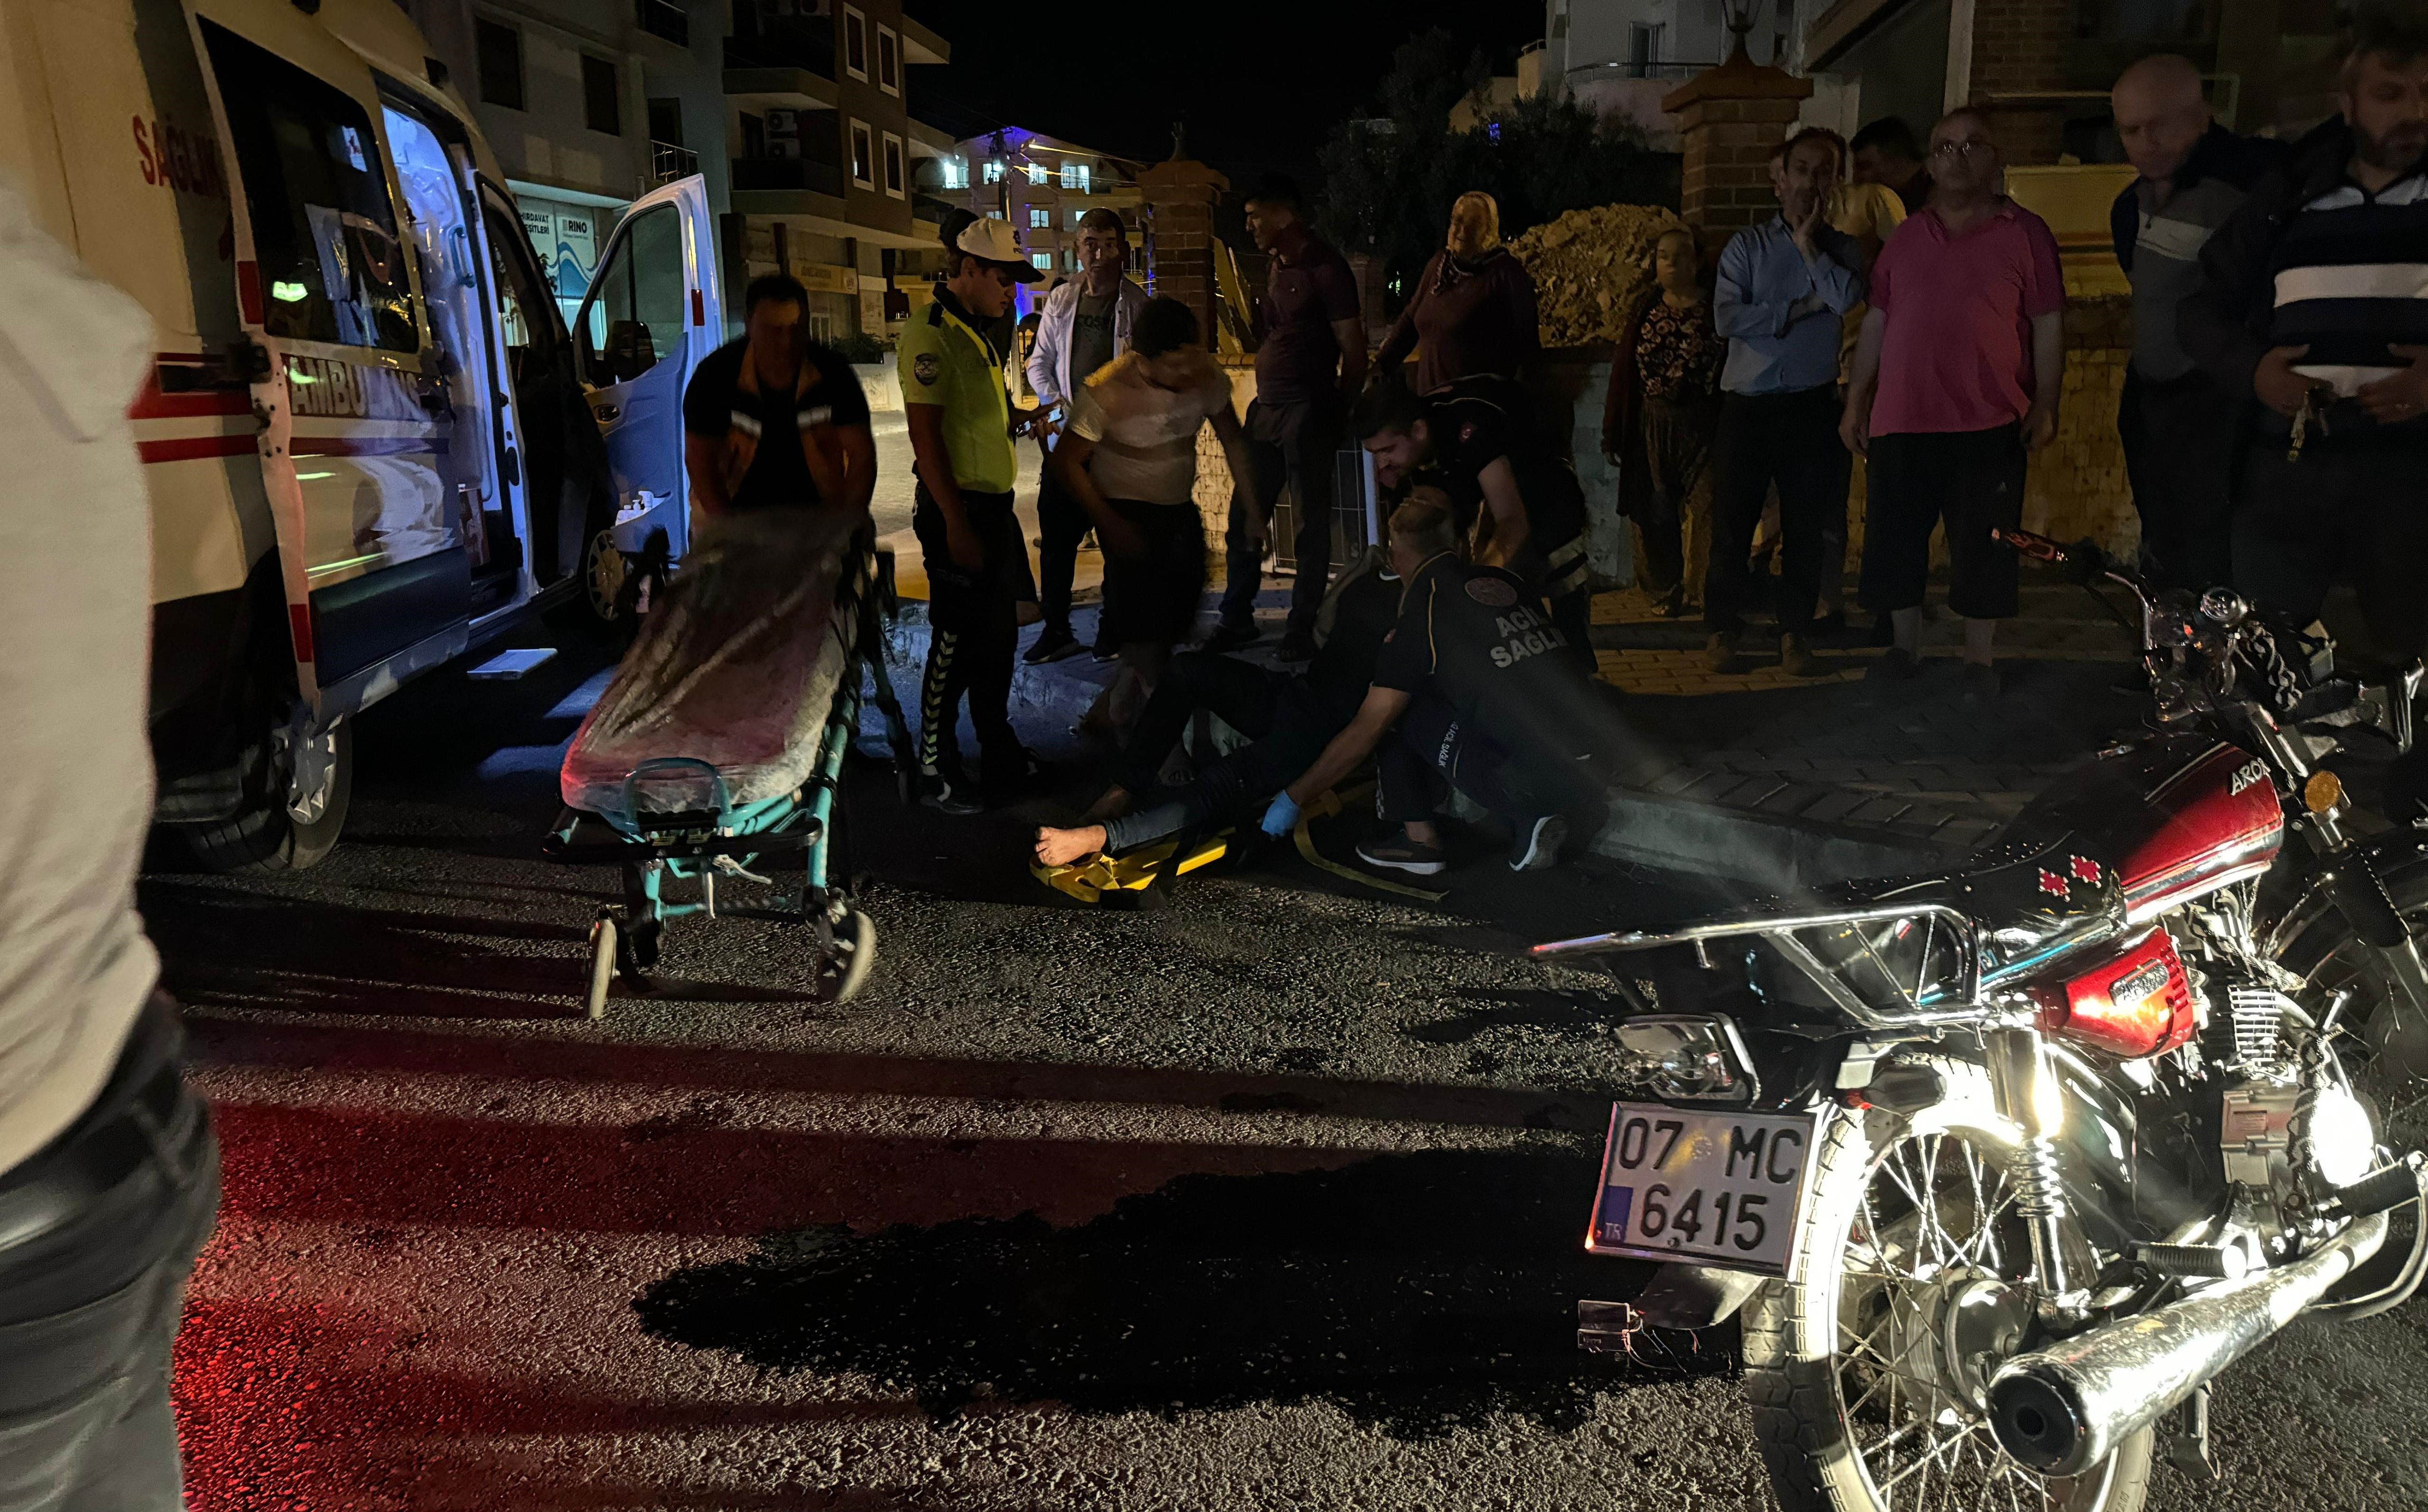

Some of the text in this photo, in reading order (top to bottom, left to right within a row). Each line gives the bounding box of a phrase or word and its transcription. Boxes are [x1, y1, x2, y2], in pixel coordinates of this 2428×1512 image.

[1619, 1118, 1801, 1184] 07 MC
[1605, 1222, 1622, 1240] TR
[1640, 1184, 1767, 1250] 6415
